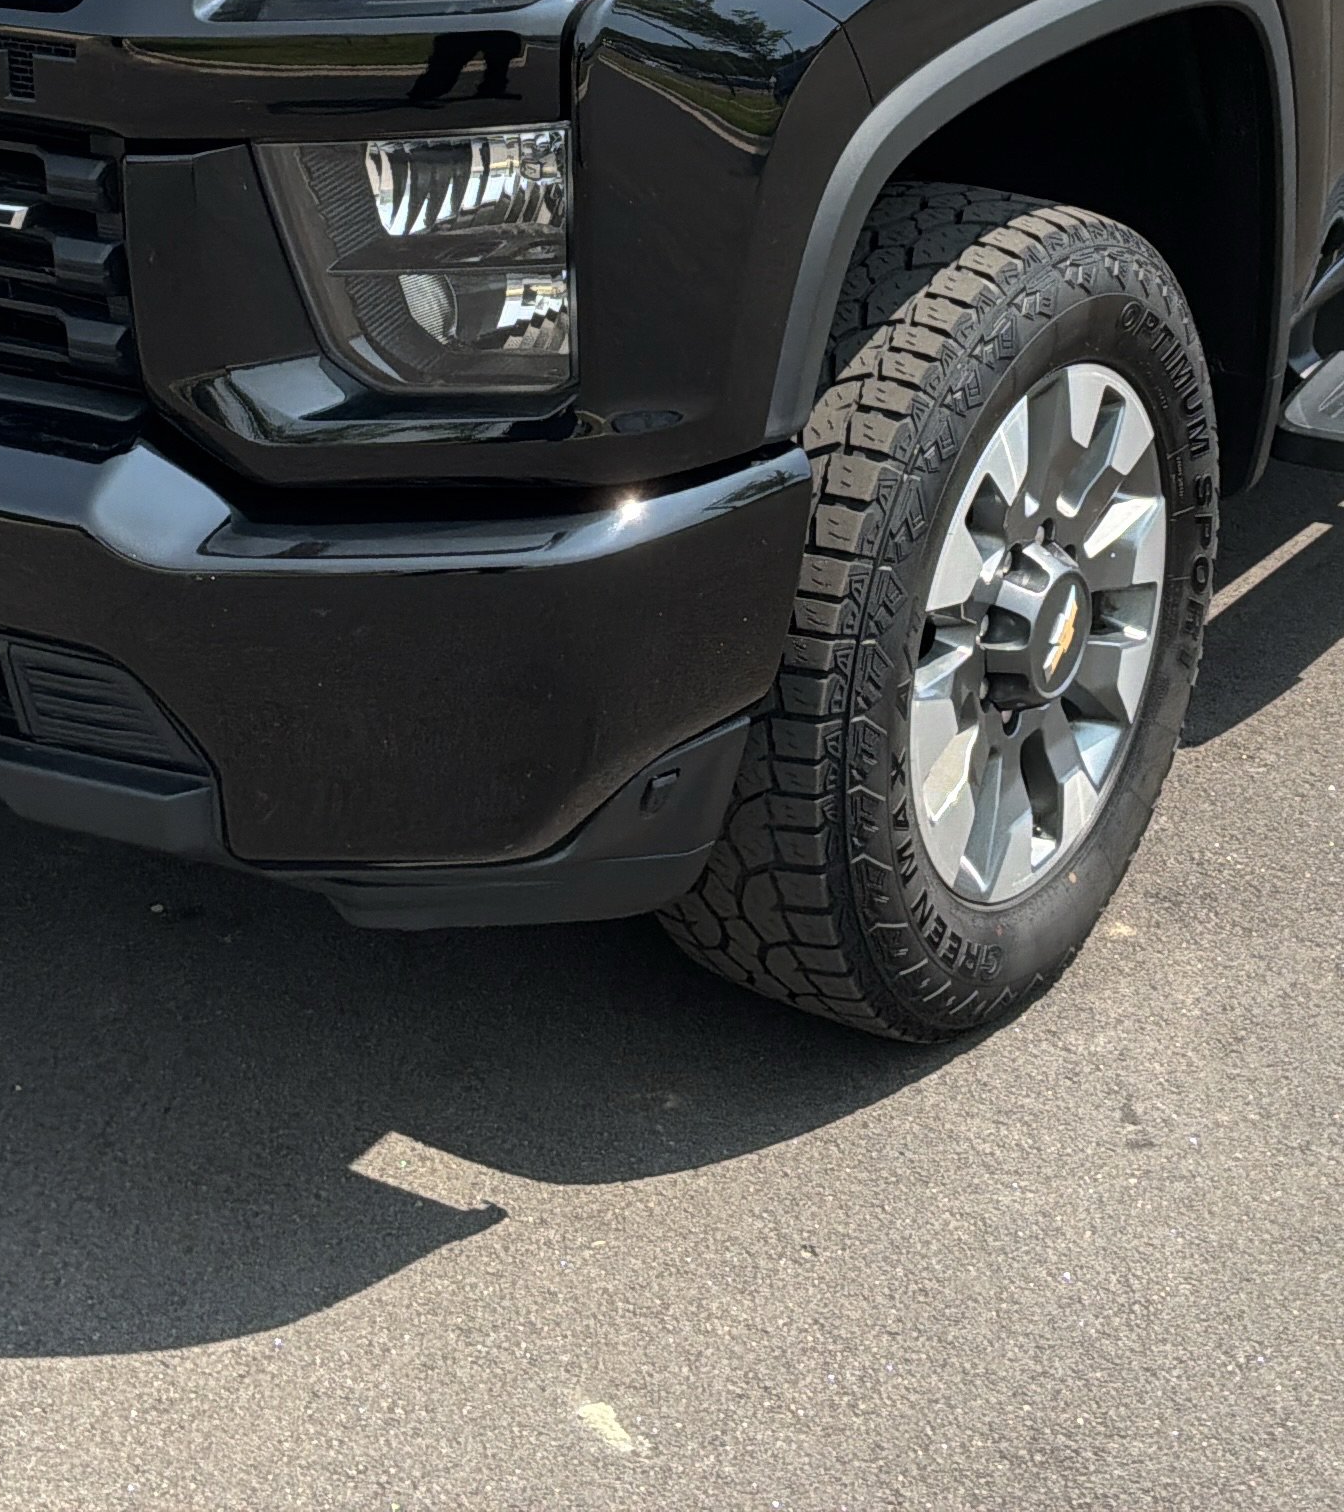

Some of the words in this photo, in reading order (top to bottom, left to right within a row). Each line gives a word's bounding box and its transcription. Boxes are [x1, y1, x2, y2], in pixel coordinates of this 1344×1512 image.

[1120, 300, 1211, 459] OPTIMUM
[890, 751, 919, 889] MAX
[910, 888, 1004, 983] GREEN
